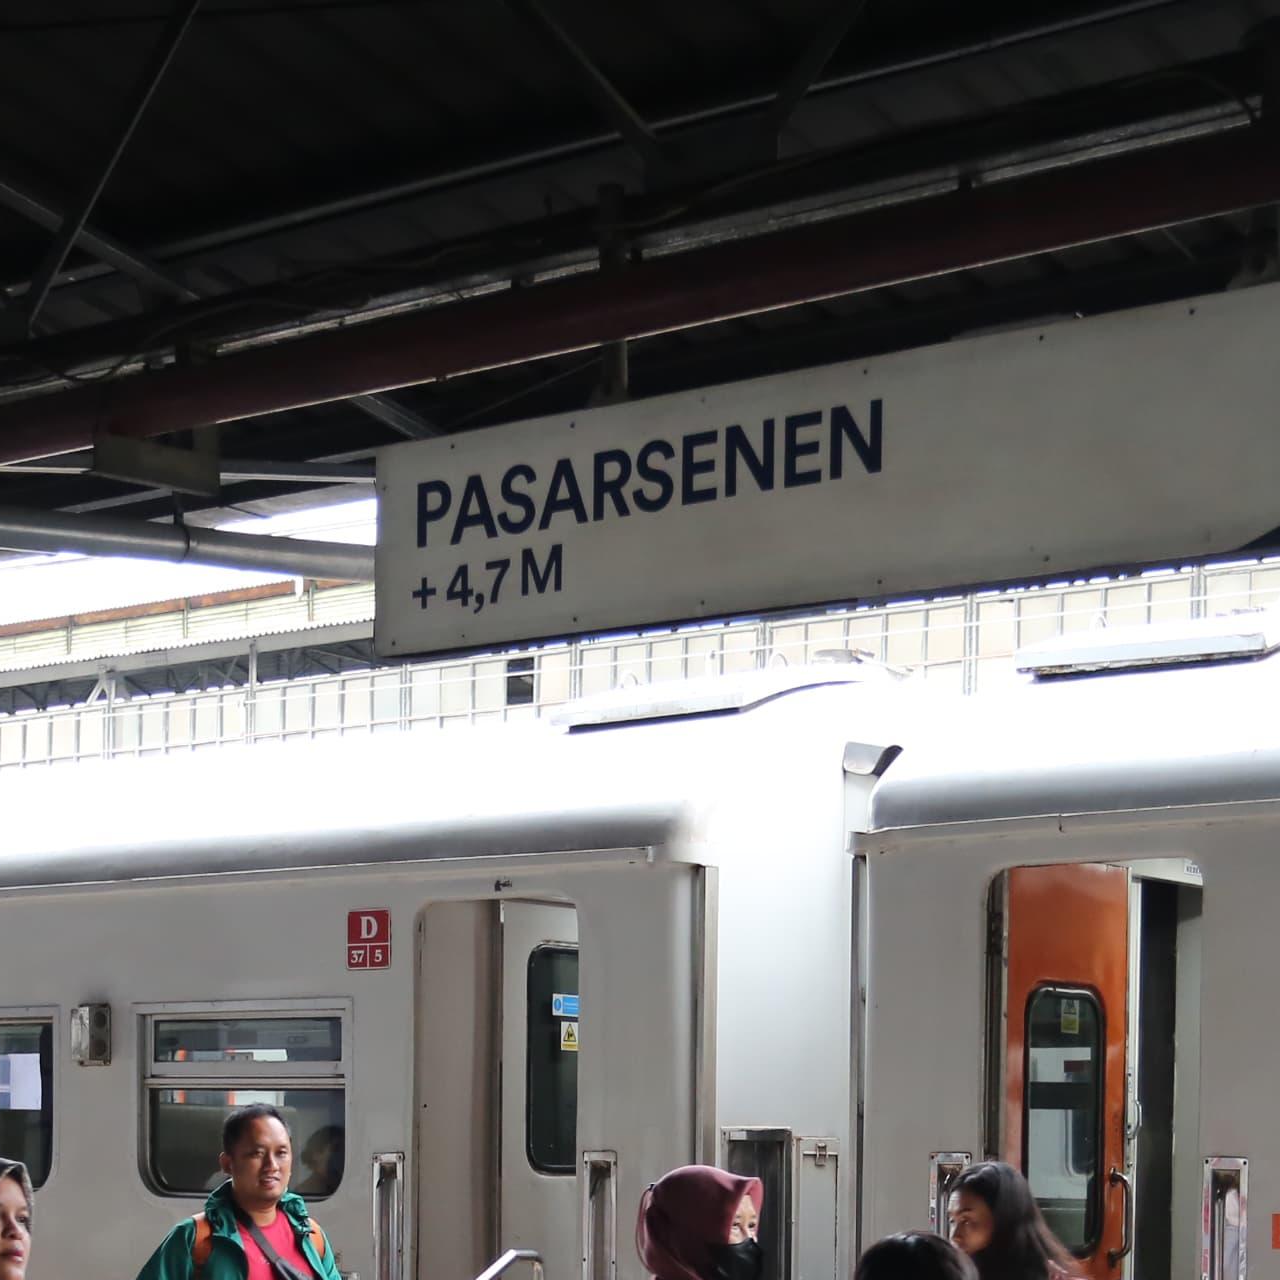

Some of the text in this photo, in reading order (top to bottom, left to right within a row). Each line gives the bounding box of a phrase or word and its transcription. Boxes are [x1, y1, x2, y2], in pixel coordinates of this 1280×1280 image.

[416, 398, 883, 549] PASARSENEN
[360, 916, 378, 939] D
[350, 949, 383, 964] 37 5
